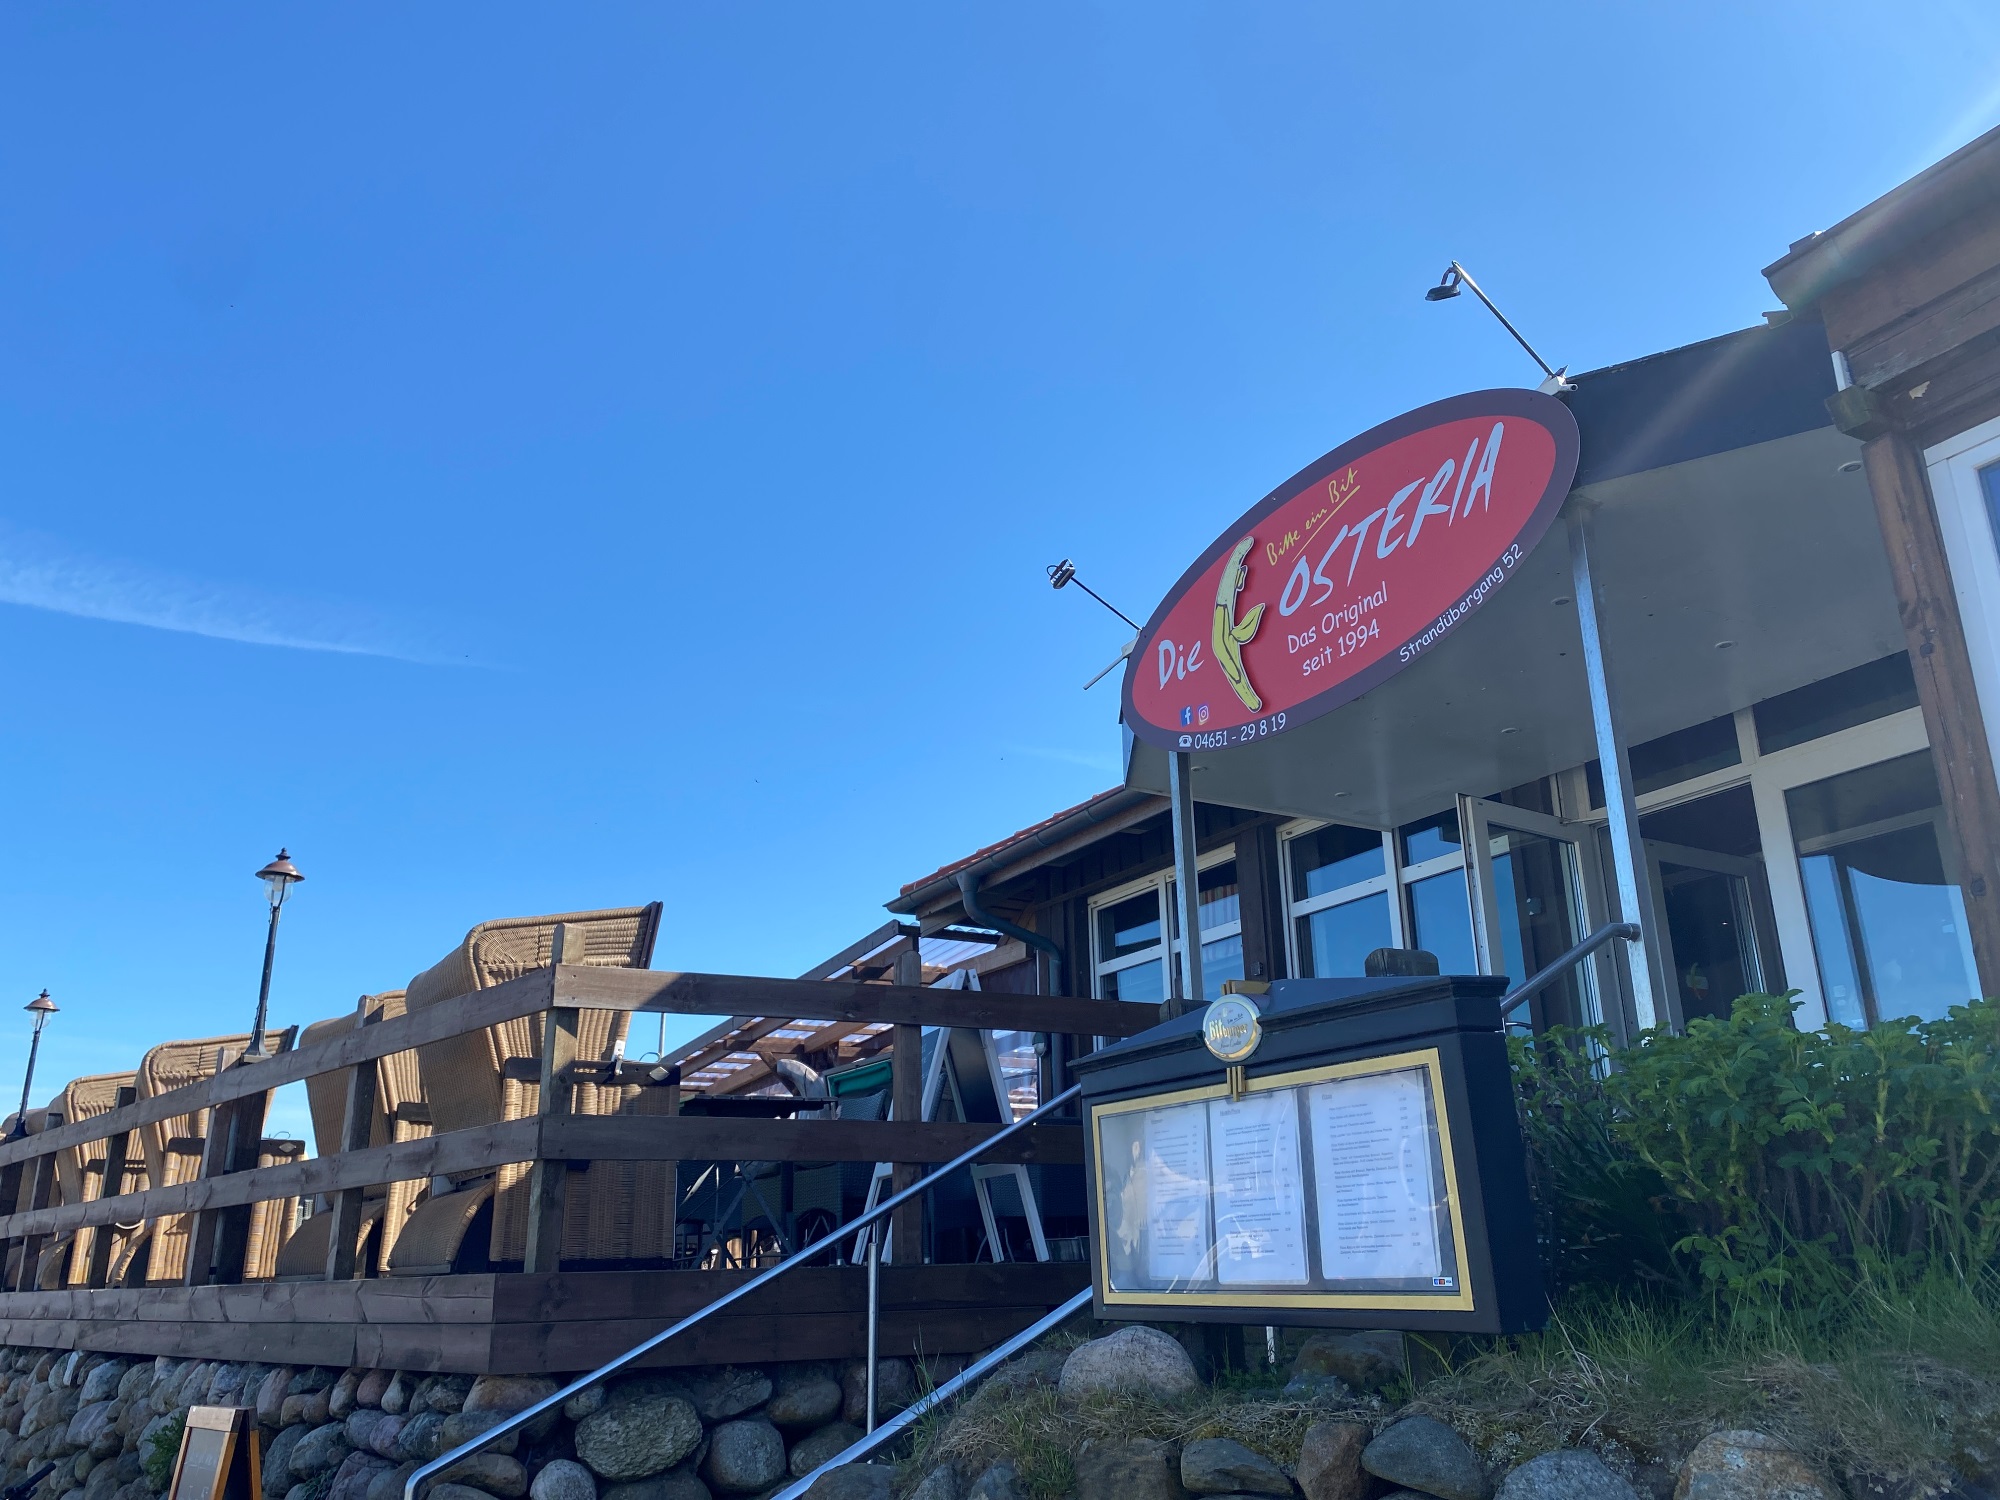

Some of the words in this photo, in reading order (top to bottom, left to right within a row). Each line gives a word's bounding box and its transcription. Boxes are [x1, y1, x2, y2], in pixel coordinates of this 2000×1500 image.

[1266, 530, 1300, 566] Bitte
[1306, 507, 1328, 530] ein
[1328, 467, 1358, 504] Bit
[1287, 625, 1317, 654] Das
[1321, 580, 1388, 634] Original
[1399, 566, 1505, 663] Strandübergang
[1501, 543, 1523, 569] 52
[1158, 639, 1204, 690] Die
[1302, 645, 1333, 676] seit
[1337, 618, 1380, 657] 1994
[1194, 730, 1228, 749] 04651
[1240, 723, 1256, 742] 29
[1259, 719, 1268, 736] 8
[1271, 712, 1286, 732] 19
